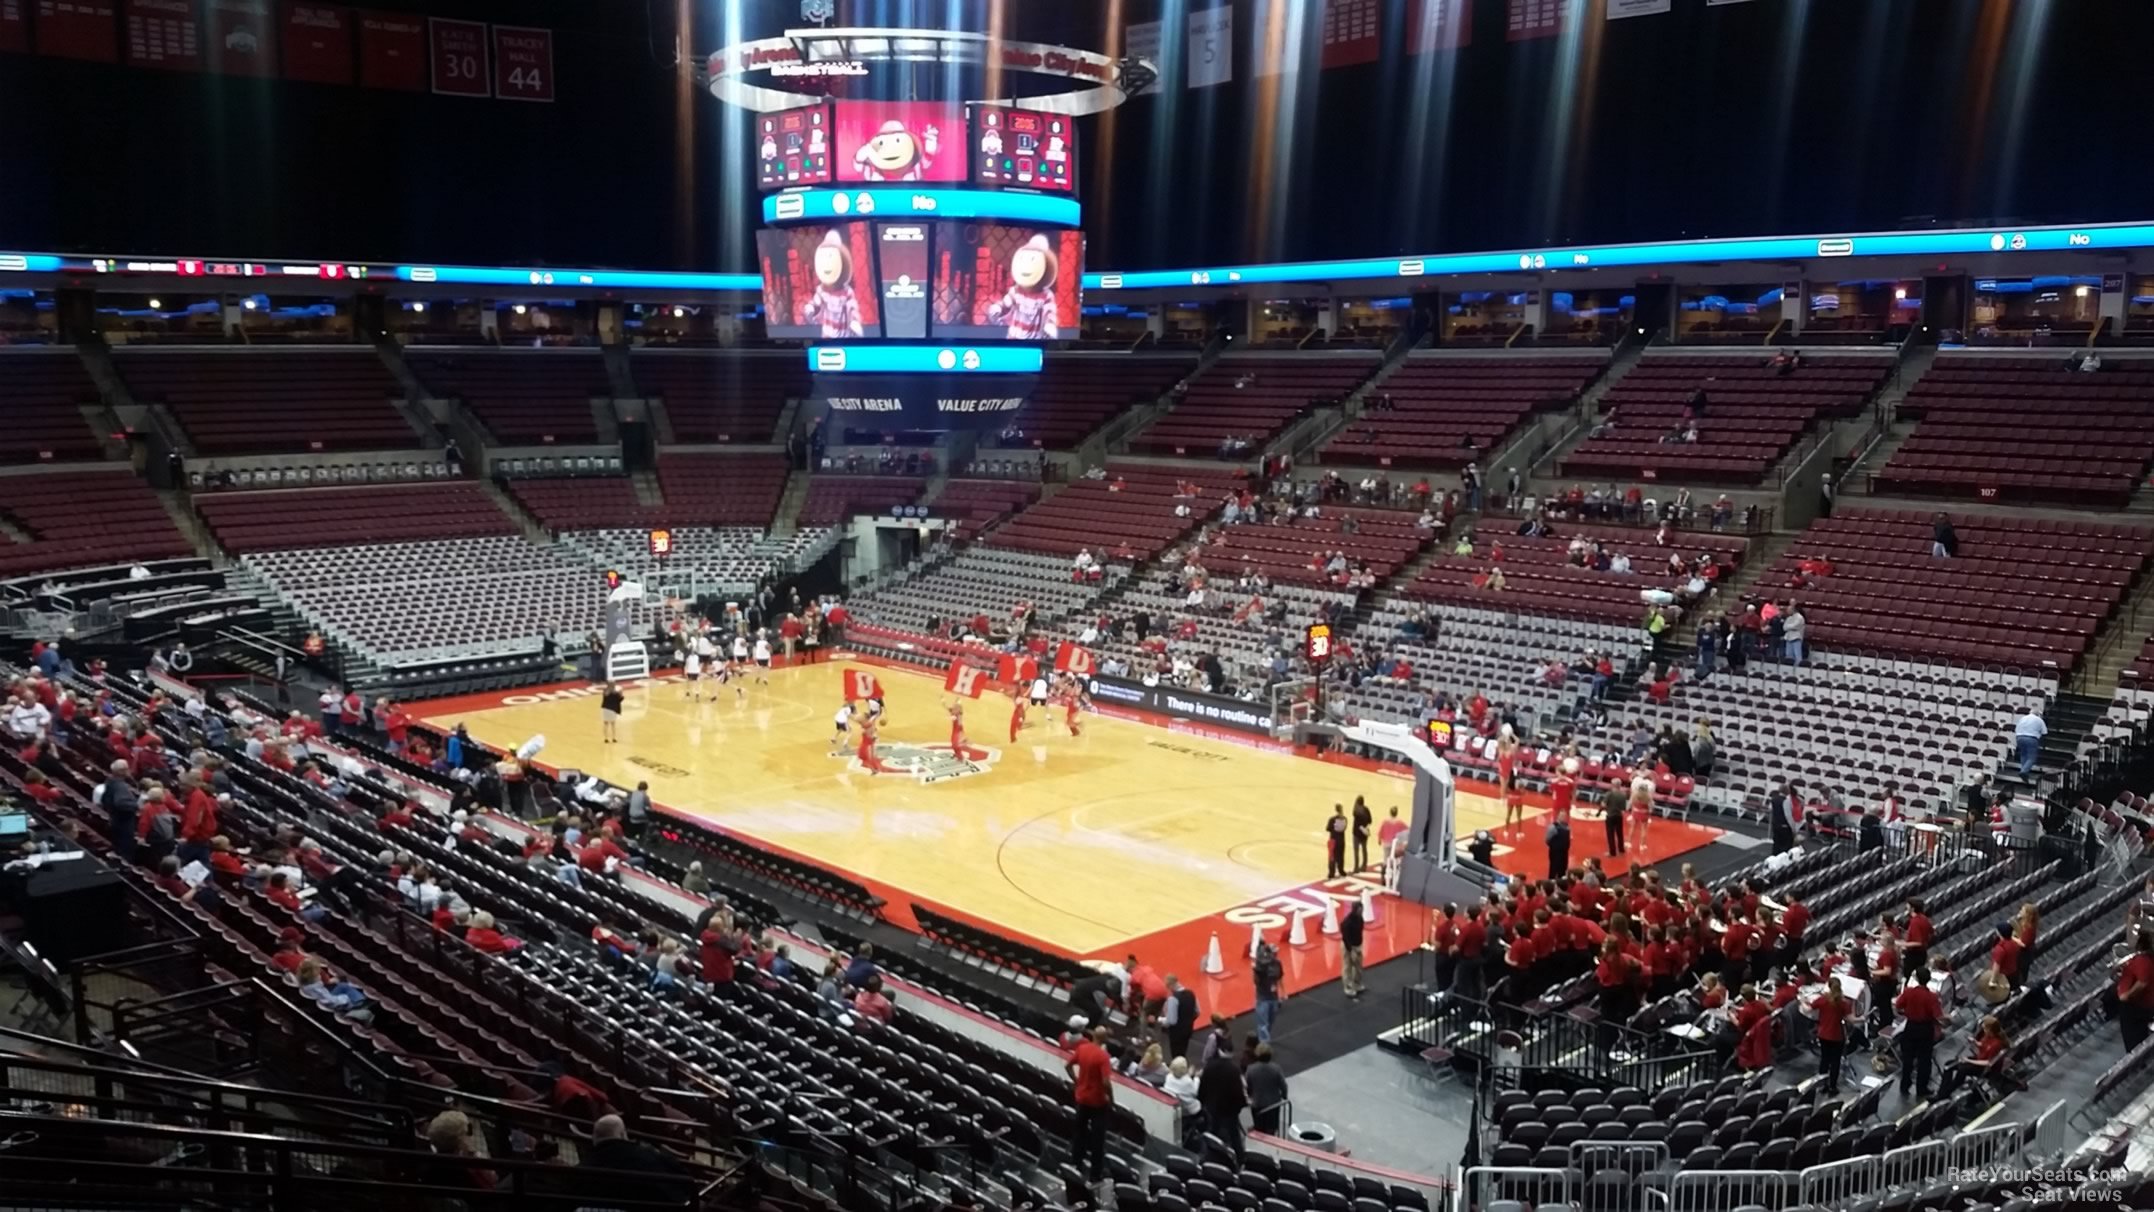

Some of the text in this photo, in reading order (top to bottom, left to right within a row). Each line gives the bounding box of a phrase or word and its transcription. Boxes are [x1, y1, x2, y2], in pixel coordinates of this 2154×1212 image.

[1204, 39, 1216, 64] 5
[445, 53, 477, 79] 30
[507, 66, 542, 92] 44
[2069, 233, 2090, 246] No
[863, 397, 903, 412] ARENA
[937, 399, 977, 412] VALUE
[978, 399, 1003, 411] CITY
[1980, 487, 1997, 497] 107
[1311, 636, 1328, 657] 30
[501, 684, 623, 705] OHIO
[1167, 695, 1194, 713] There
[1195, 701, 1205, 715] is
[1206, 705, 1219, 719] no
[1220, 709, 1257, 725] routine
